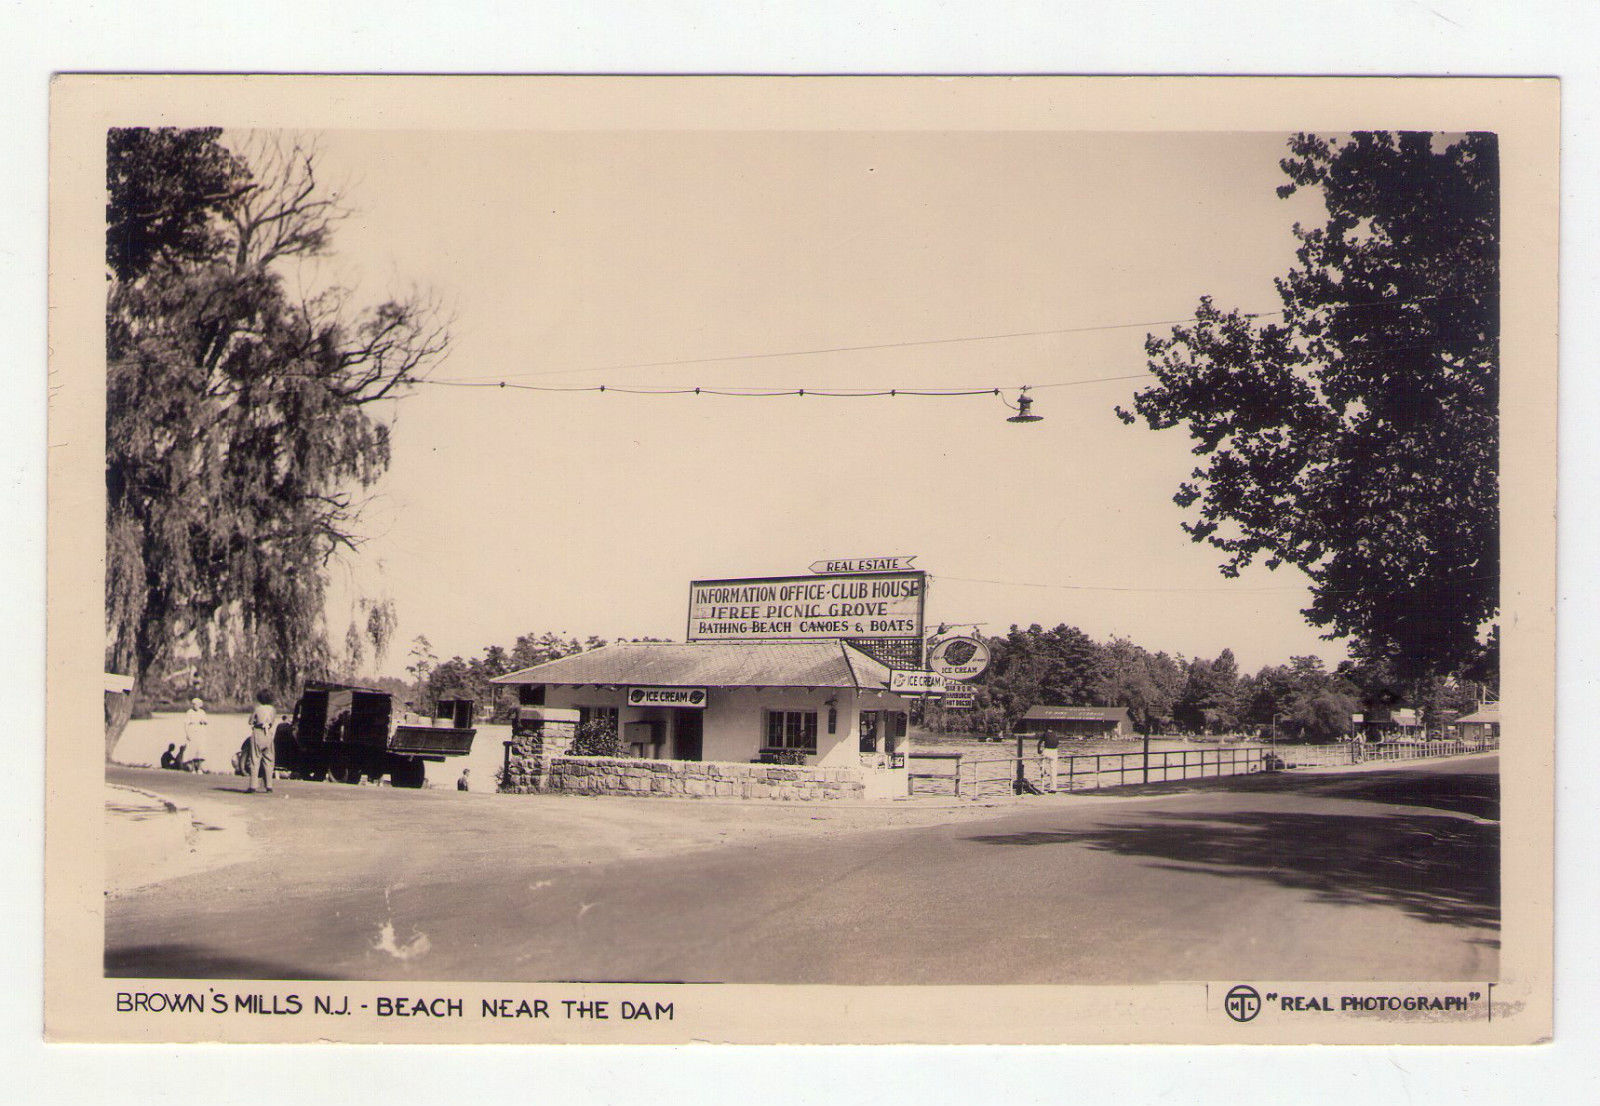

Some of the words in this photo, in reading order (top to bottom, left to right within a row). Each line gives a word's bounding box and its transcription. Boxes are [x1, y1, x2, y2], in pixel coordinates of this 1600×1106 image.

[826, 561, 854, 572] REAL
[858, 558, 899, 570] ESTATE
[696, 586, 777, 604] INFORMATION
[872, 580, 920, 598] HOUSE
[766, 604, 820, 619] PICNIC
[828, 602, 888, 617] GROVE
[698, 621, 747, 634] BATHING
[751, 620, 792, 633] BEACH
[800, 620, 849, 633] CANOES
[855, 622, 864, 634] &
[870, 619, 914, 632] BOATS
[907, 675, 918, 687] ICE
[919, 675, 941, 688] CREAM
[646, 691, 659, 702] ICE
[660, 691, 688, 703] CREAM
